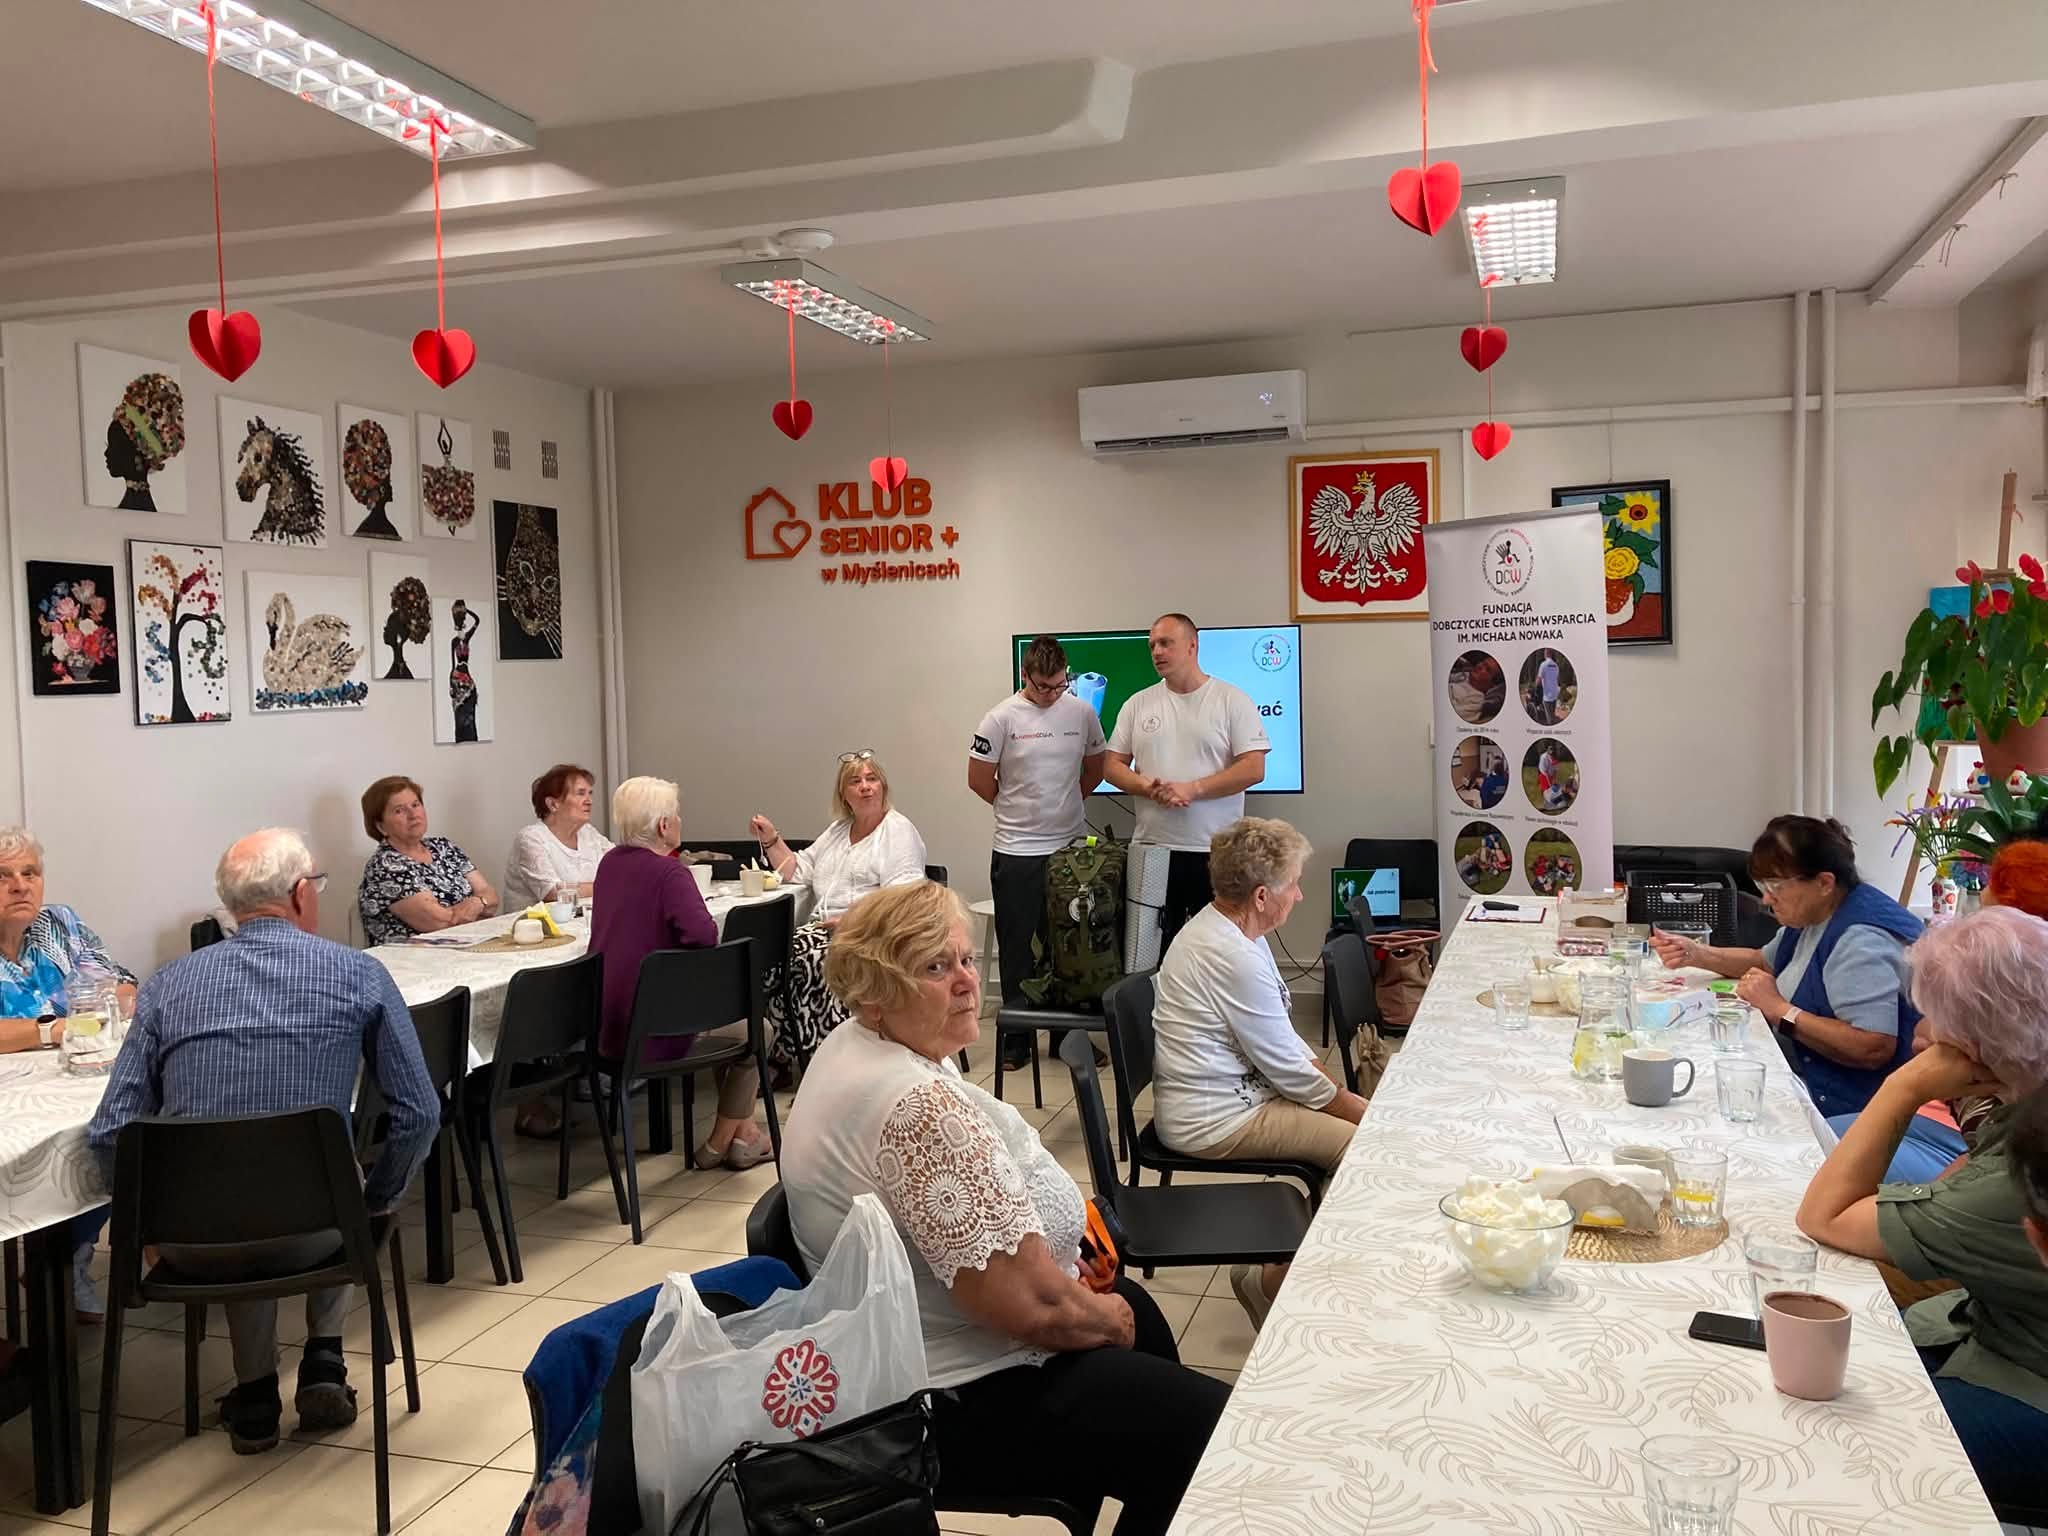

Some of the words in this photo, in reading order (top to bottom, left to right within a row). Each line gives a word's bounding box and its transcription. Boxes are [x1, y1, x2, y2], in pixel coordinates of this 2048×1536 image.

[818, 477, 933, 520] KLUB
[820, 523, 933, 554] SENIOR
[821, 567, 838, 583] w
[842, 558, 960, 586] Myślenicach
[1495, 568, 1522, 585] DCW
[1482, 602, 1533, 615] FUNDACJA
[1432, 618, 1490, 631] DOBCZYCKIE
[1492, 615, 1540, 629] CENTRUM
[1540, 613, 1597, 626] WSPARCIA
[1457, 632, 1471, 644] IM.
[1471, 631, 1517, 643] MICHAŁA
[1518, 629, 1564, 641] NOWAKA
[1261, 656, 1282, 666] DCW
